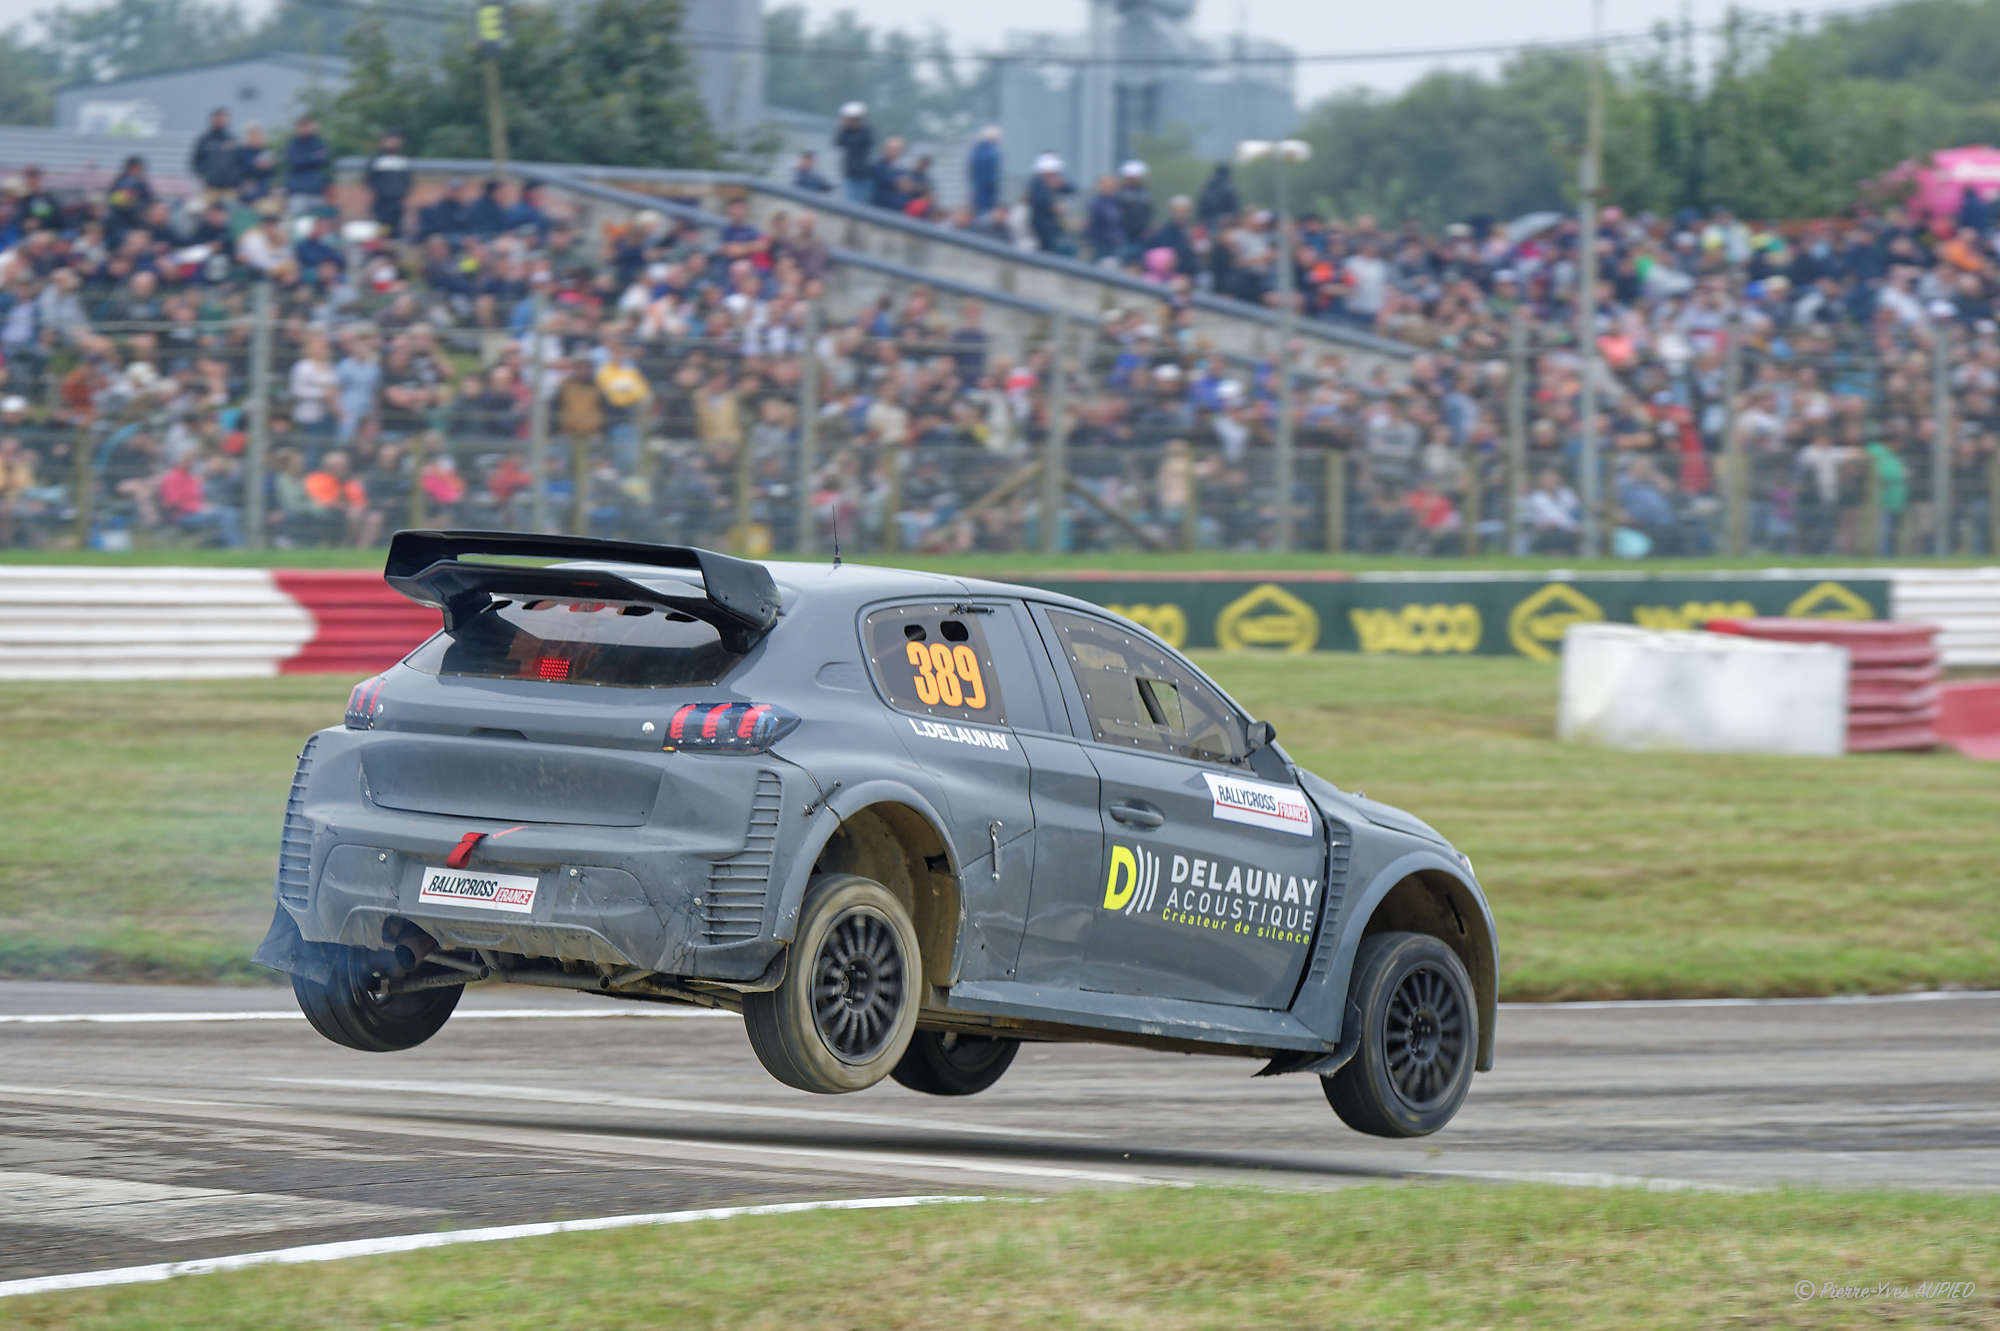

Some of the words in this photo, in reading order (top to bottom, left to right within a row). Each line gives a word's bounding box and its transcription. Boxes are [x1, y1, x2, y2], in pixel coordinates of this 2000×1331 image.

[1349, 602, 1483, 654] YACCO
[906, 641, 987, 709] 389
[908, 718, 1009, 751] L.DELAUNAY
[1217, 784, 1277, 812] RALLYCROSS
[1278, 802, 1309, 823] FRANCE
[428, 875, 498, 897] RALLYCROSS
[496, 888, 532, 905] FRANCE
[1103, 845, 1137, 911] D
[1171, 854, 1318, 907] DELAUNAY
[1162, 908, 1227, 931] Créateur
[1234, 920, 1250, 936] de
[1257, 925, 1310, 945] silence
[1166, 887, 1315, 932] ACOUSTIQUE
